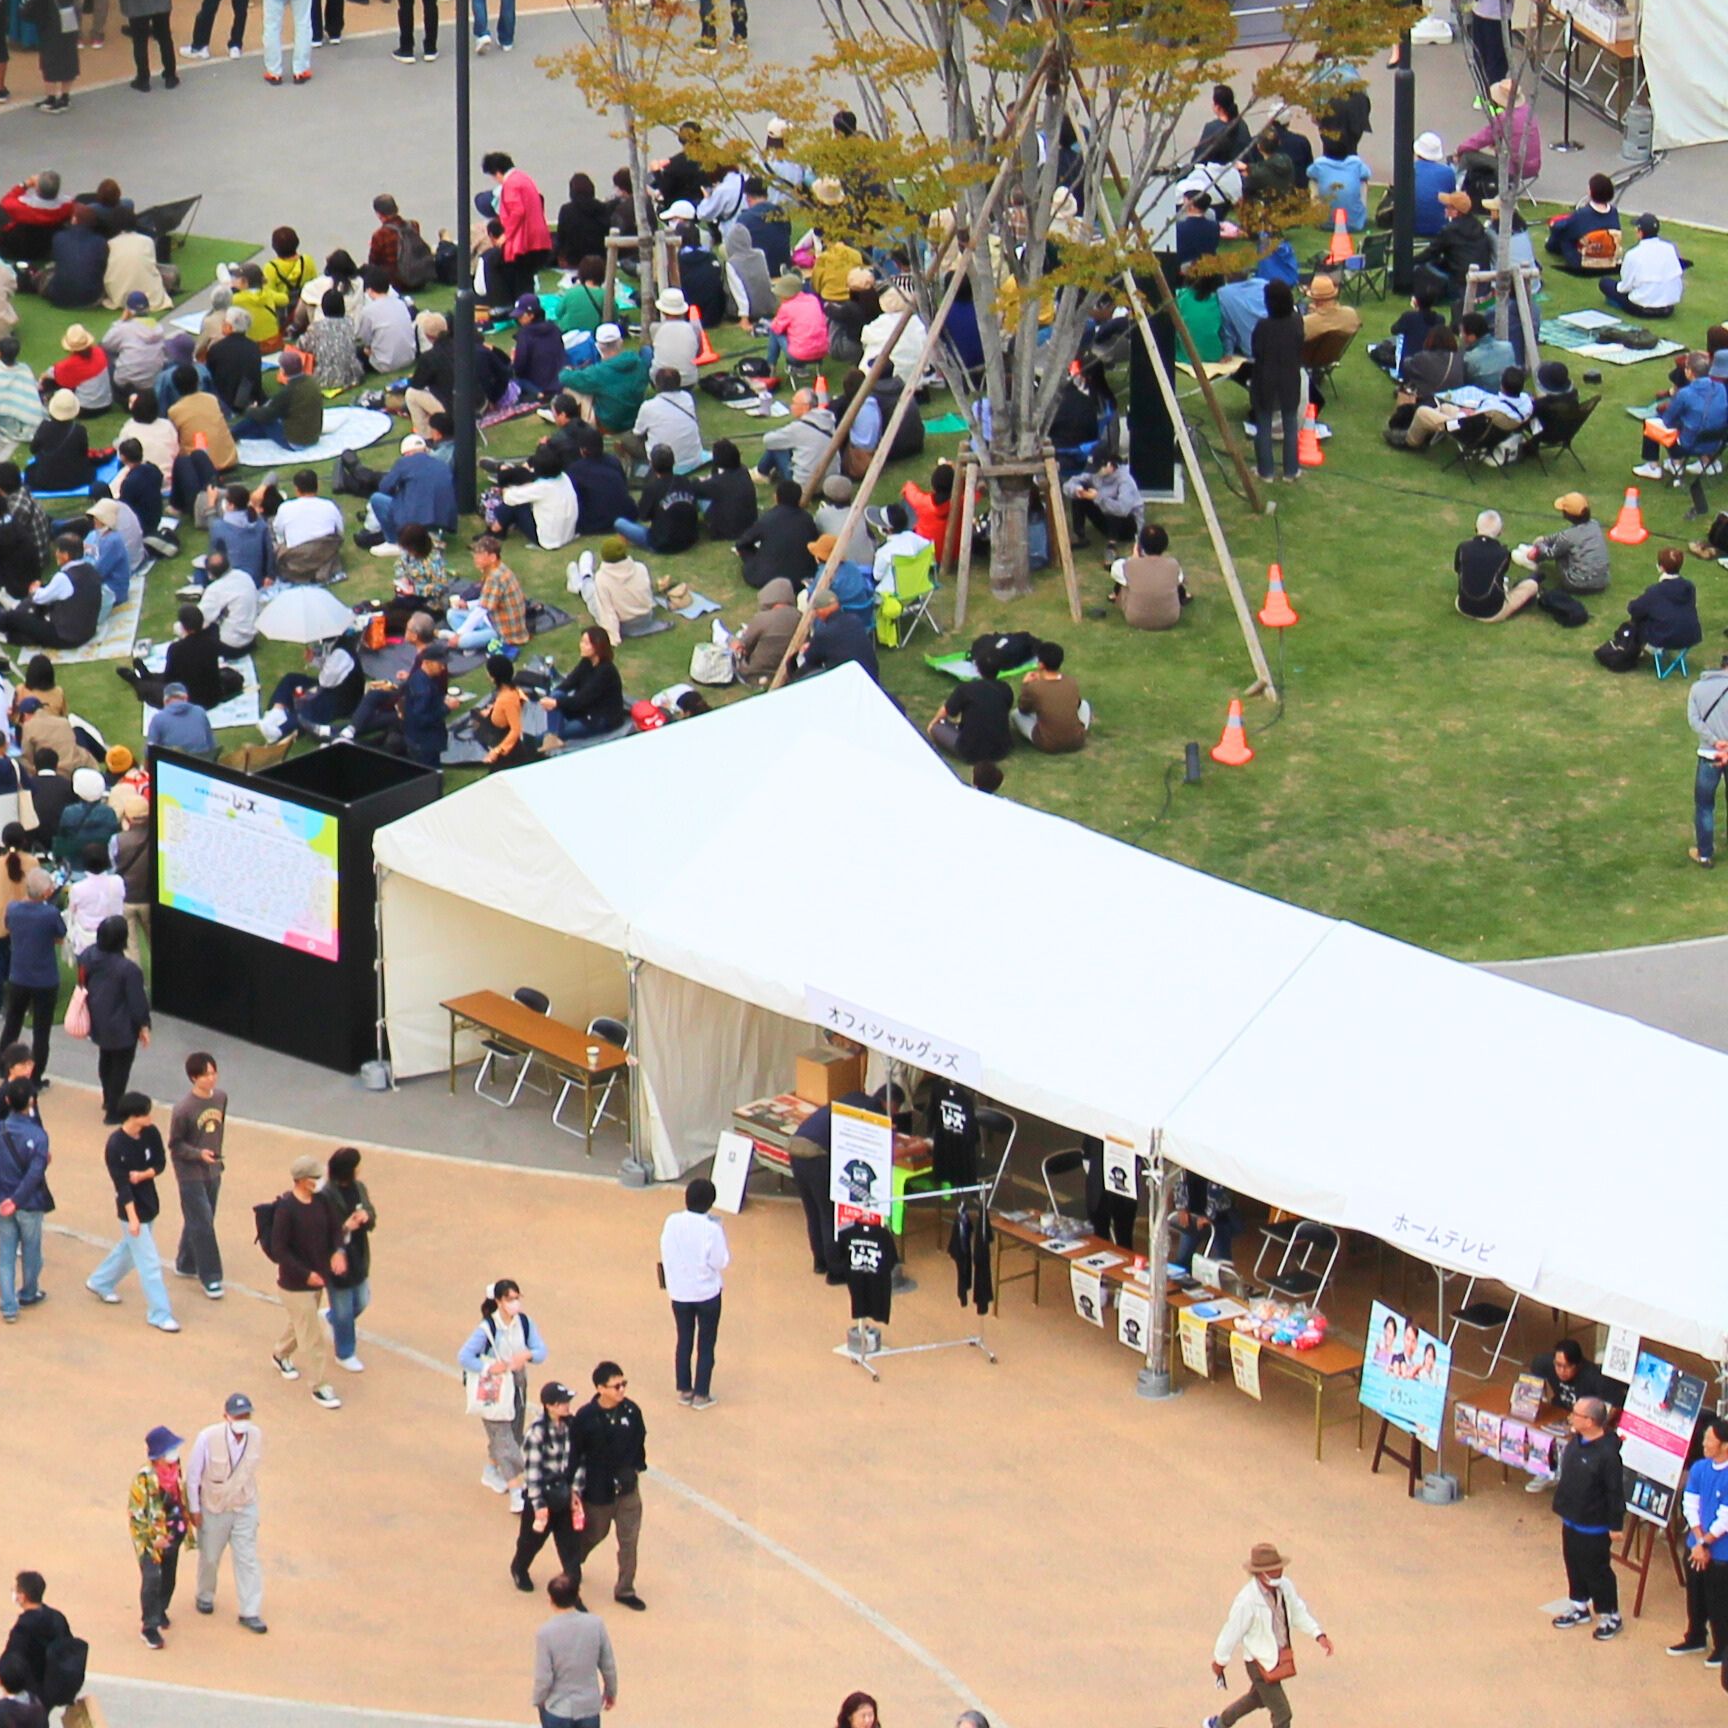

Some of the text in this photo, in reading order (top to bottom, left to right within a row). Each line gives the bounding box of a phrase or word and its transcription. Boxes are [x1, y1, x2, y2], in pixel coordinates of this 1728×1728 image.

[828, 1005, 960, 1071] オフィシャルグッズ
[1392, 1213, 1496, 1263] ホームテレビ
